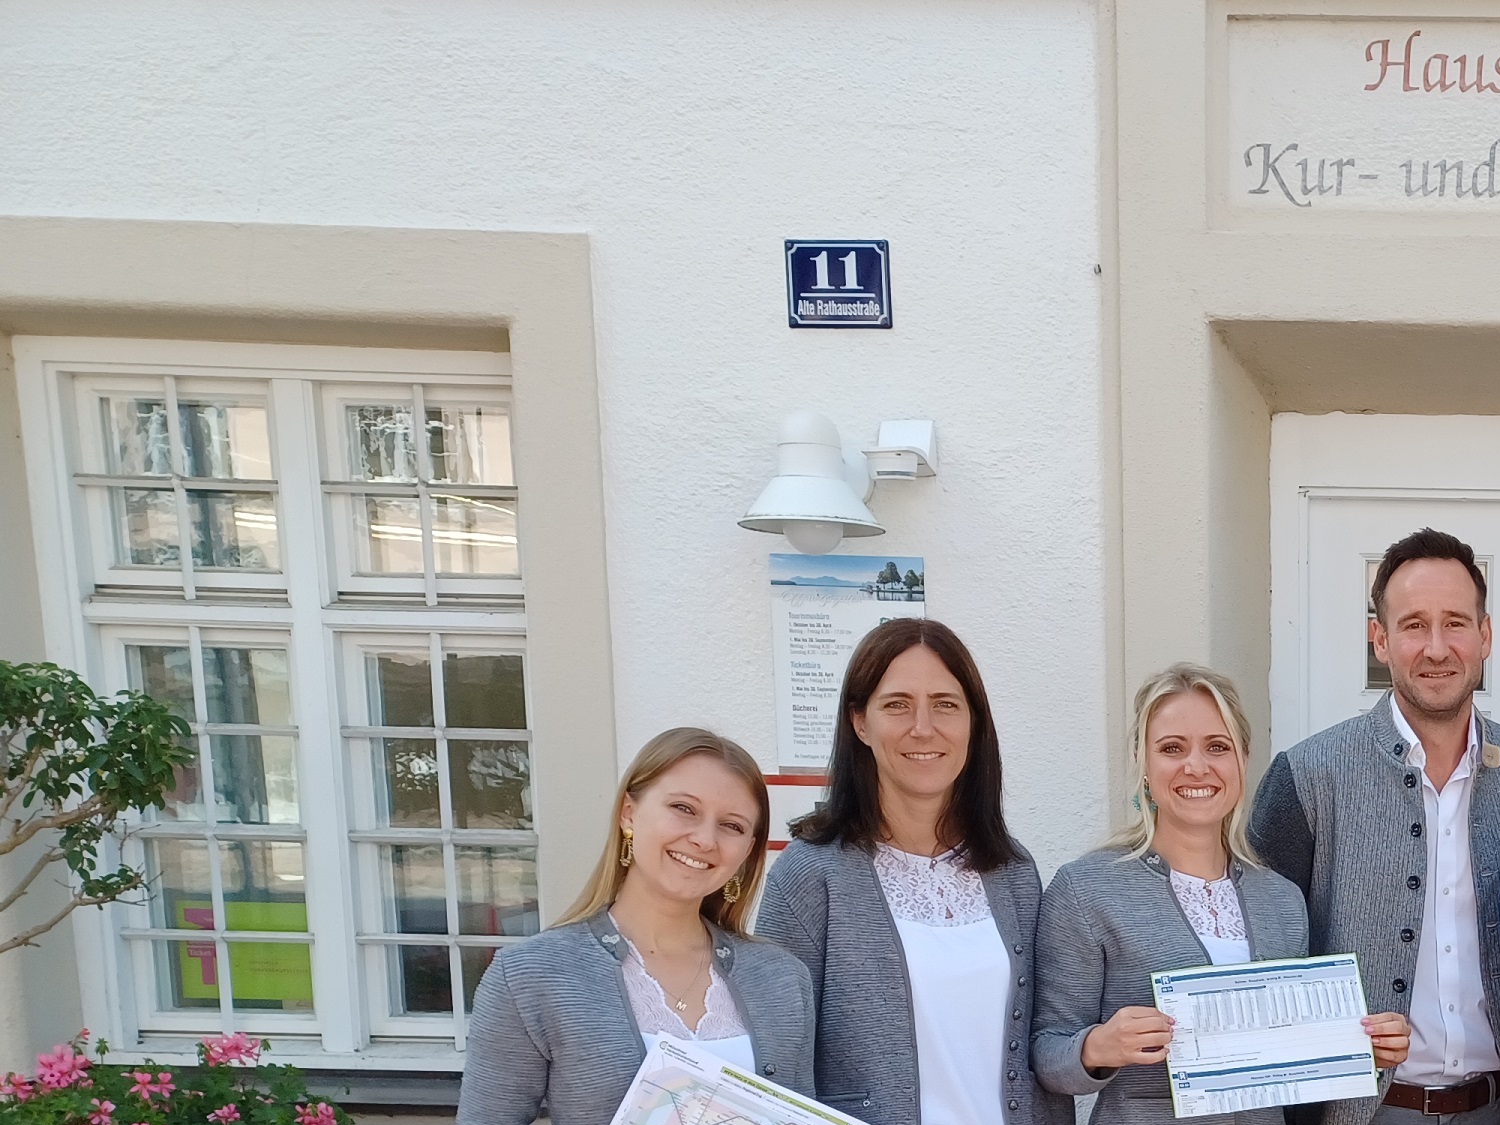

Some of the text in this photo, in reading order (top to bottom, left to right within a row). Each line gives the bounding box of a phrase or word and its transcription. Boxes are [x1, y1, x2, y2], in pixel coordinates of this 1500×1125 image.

[1243, 142, 1379, 208] Kur-
[809, 250, 864, 290] 11
[797, 299, 880, 316] Alte Rathausstraße
